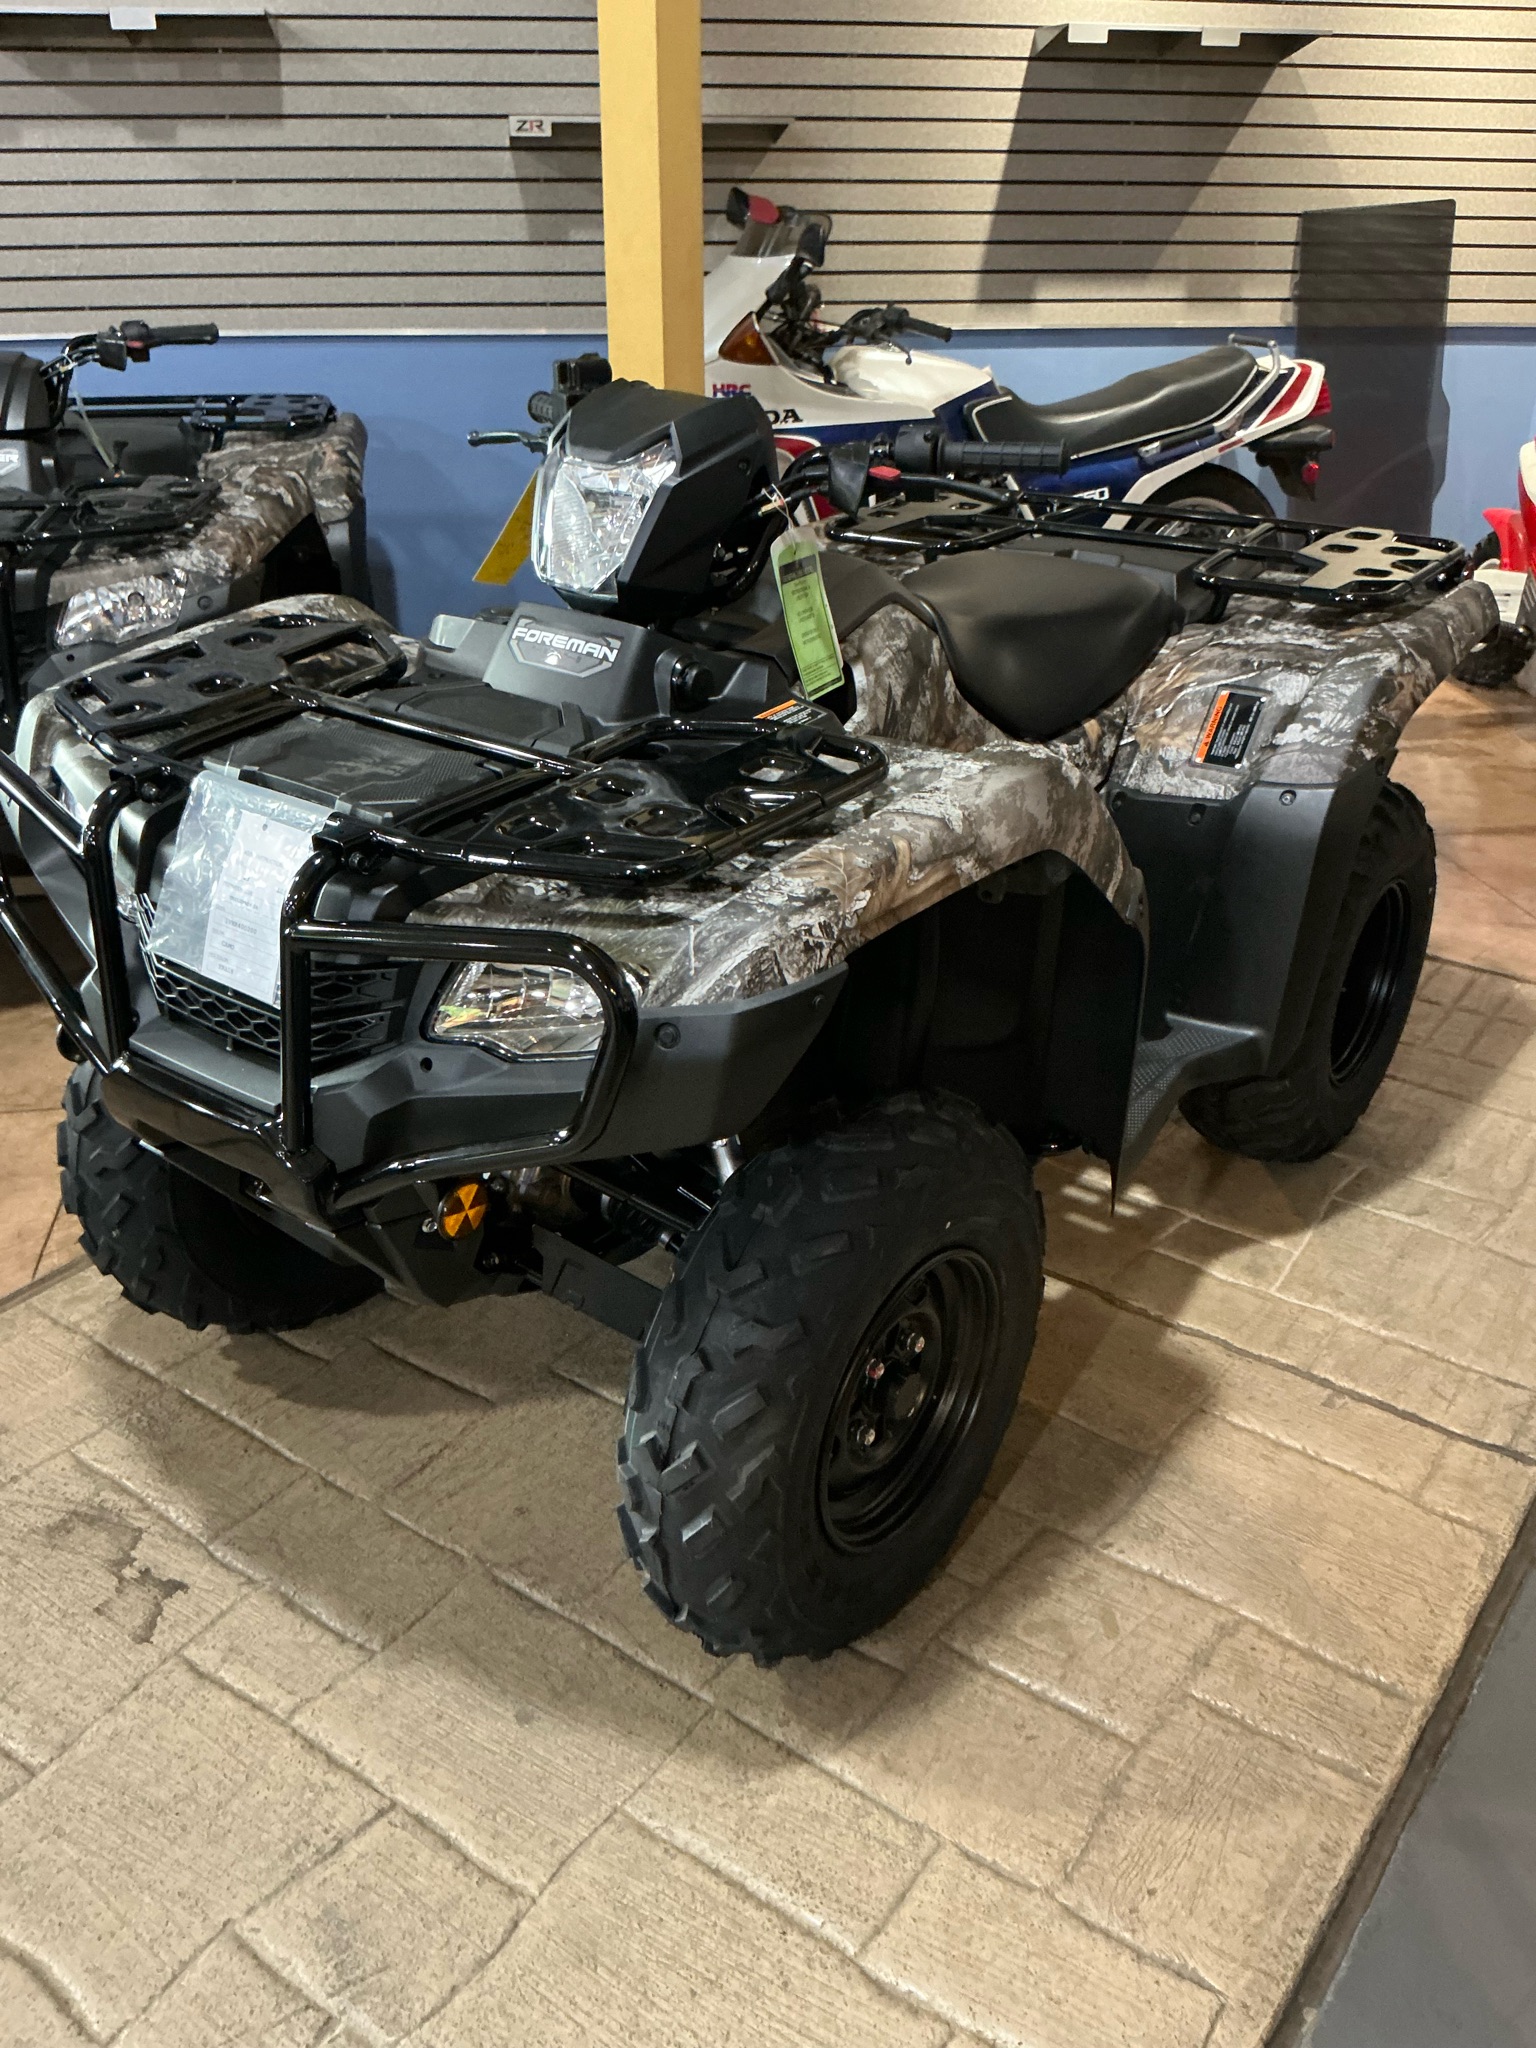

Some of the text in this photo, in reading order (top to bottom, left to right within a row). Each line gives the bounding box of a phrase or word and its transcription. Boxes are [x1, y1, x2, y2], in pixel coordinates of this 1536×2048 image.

[515, 119, 545, 133] ZR
[712, 383, 752, 398] HRC
[511, 626, 619, 663] FOREMAN
[1205, 706, 1223, 739] WARNING
